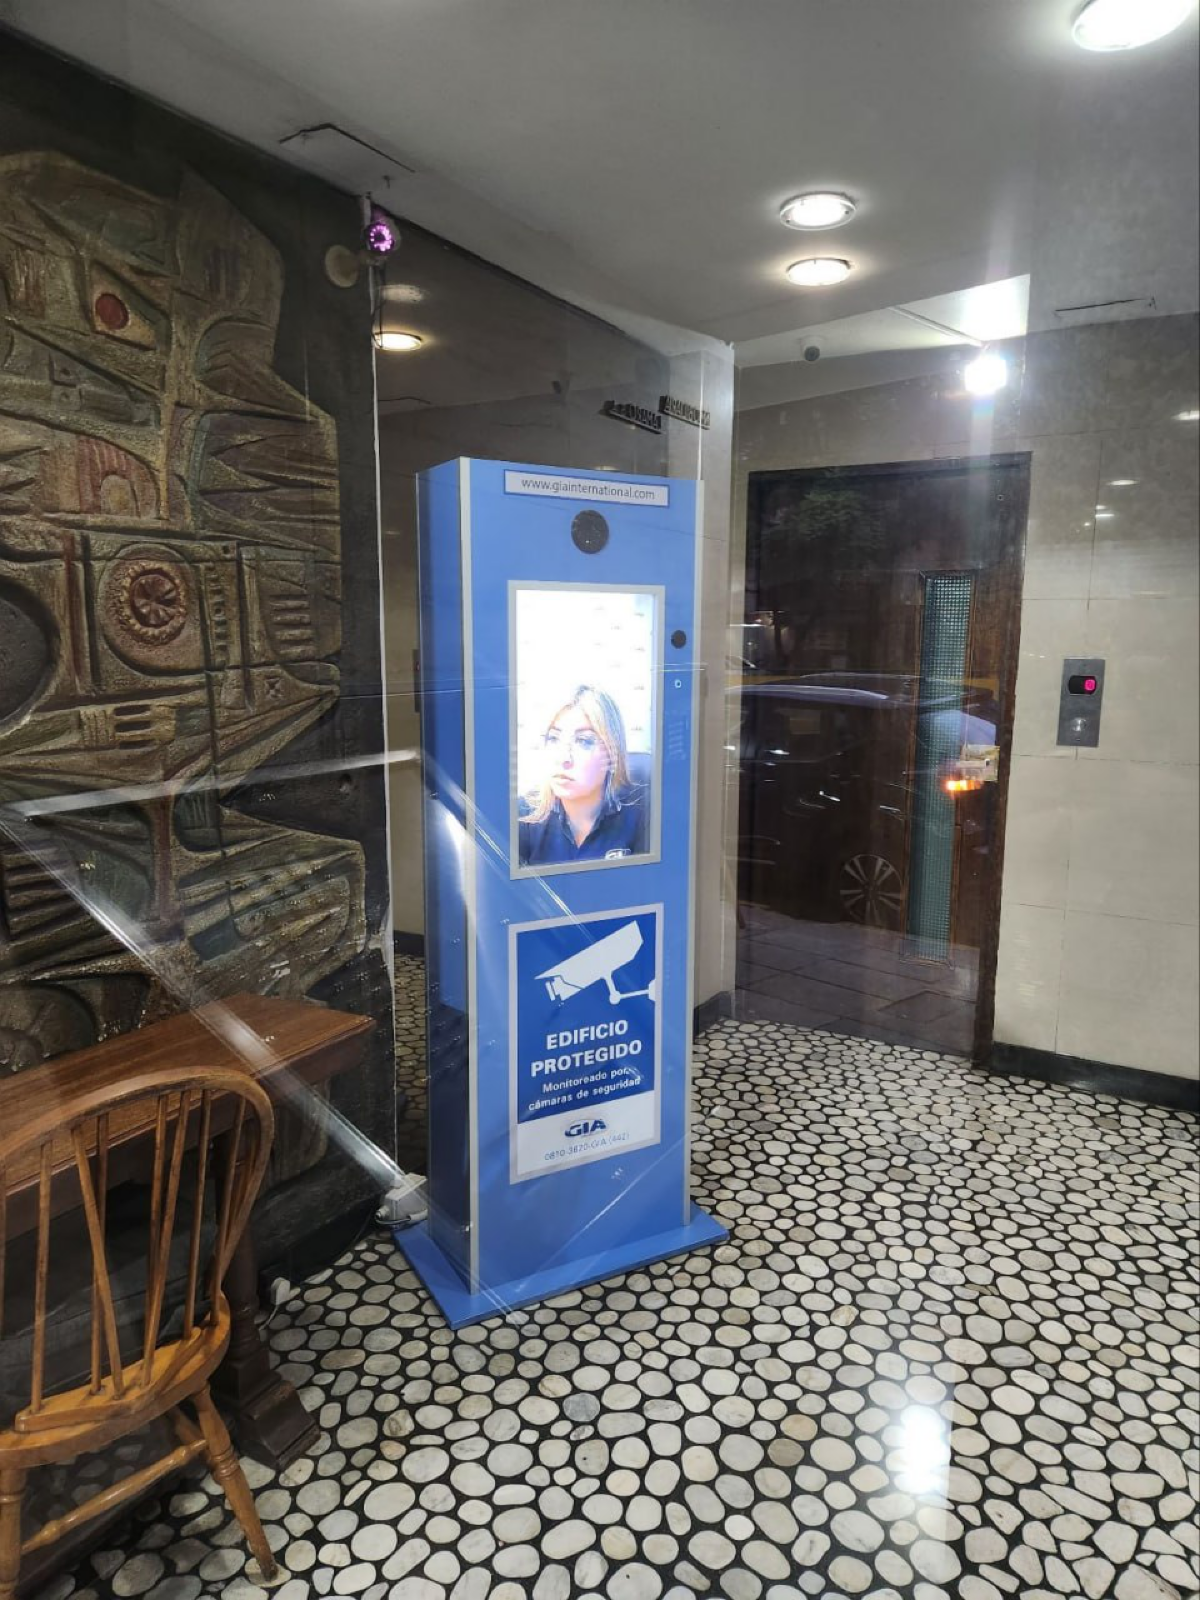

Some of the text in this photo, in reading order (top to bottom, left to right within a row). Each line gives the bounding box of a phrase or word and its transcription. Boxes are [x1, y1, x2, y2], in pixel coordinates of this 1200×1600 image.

[521, 478, 654, 500] www.giainternational.com
[546, 1019, 629, 1050] EDIFICIO
[531, 1040, 642, 1077] PROTEGIDO
[528, 1076, 641, 1111] cámaras de seguridad
[542, 1070, 607, 1094] Monitoreado
[564, 1119, 607, 1137] GIA
